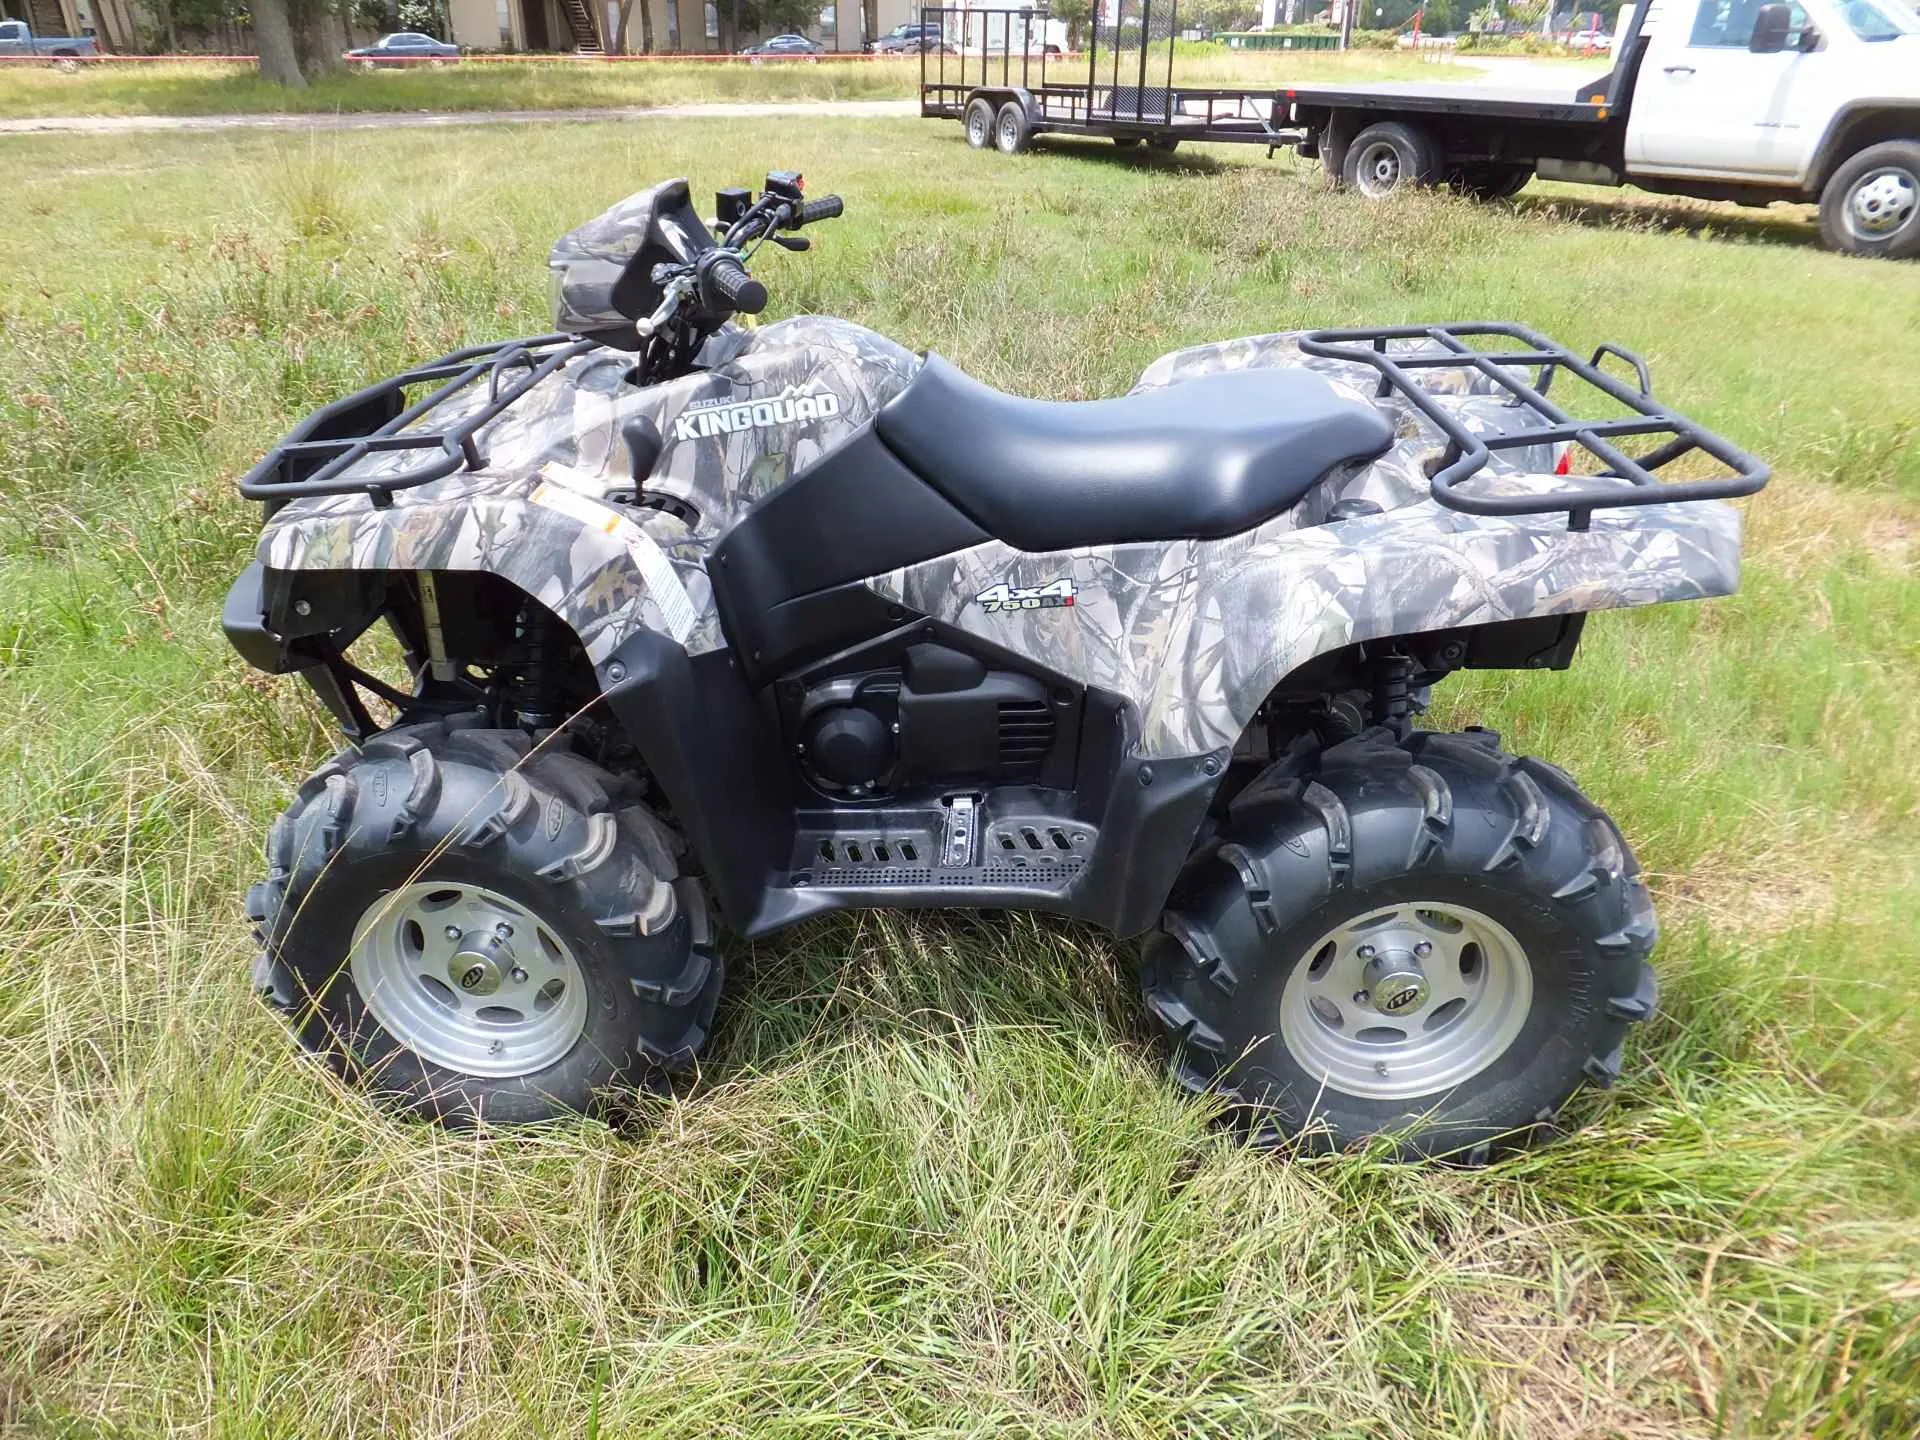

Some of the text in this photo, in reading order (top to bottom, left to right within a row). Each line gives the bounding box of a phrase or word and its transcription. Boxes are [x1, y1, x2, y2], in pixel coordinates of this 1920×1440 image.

[674, 393, 840, 441] KINGQUAD
[976, 578, 1078, 602] 4x4
[1389, 989, 1416, 1009] ITP
